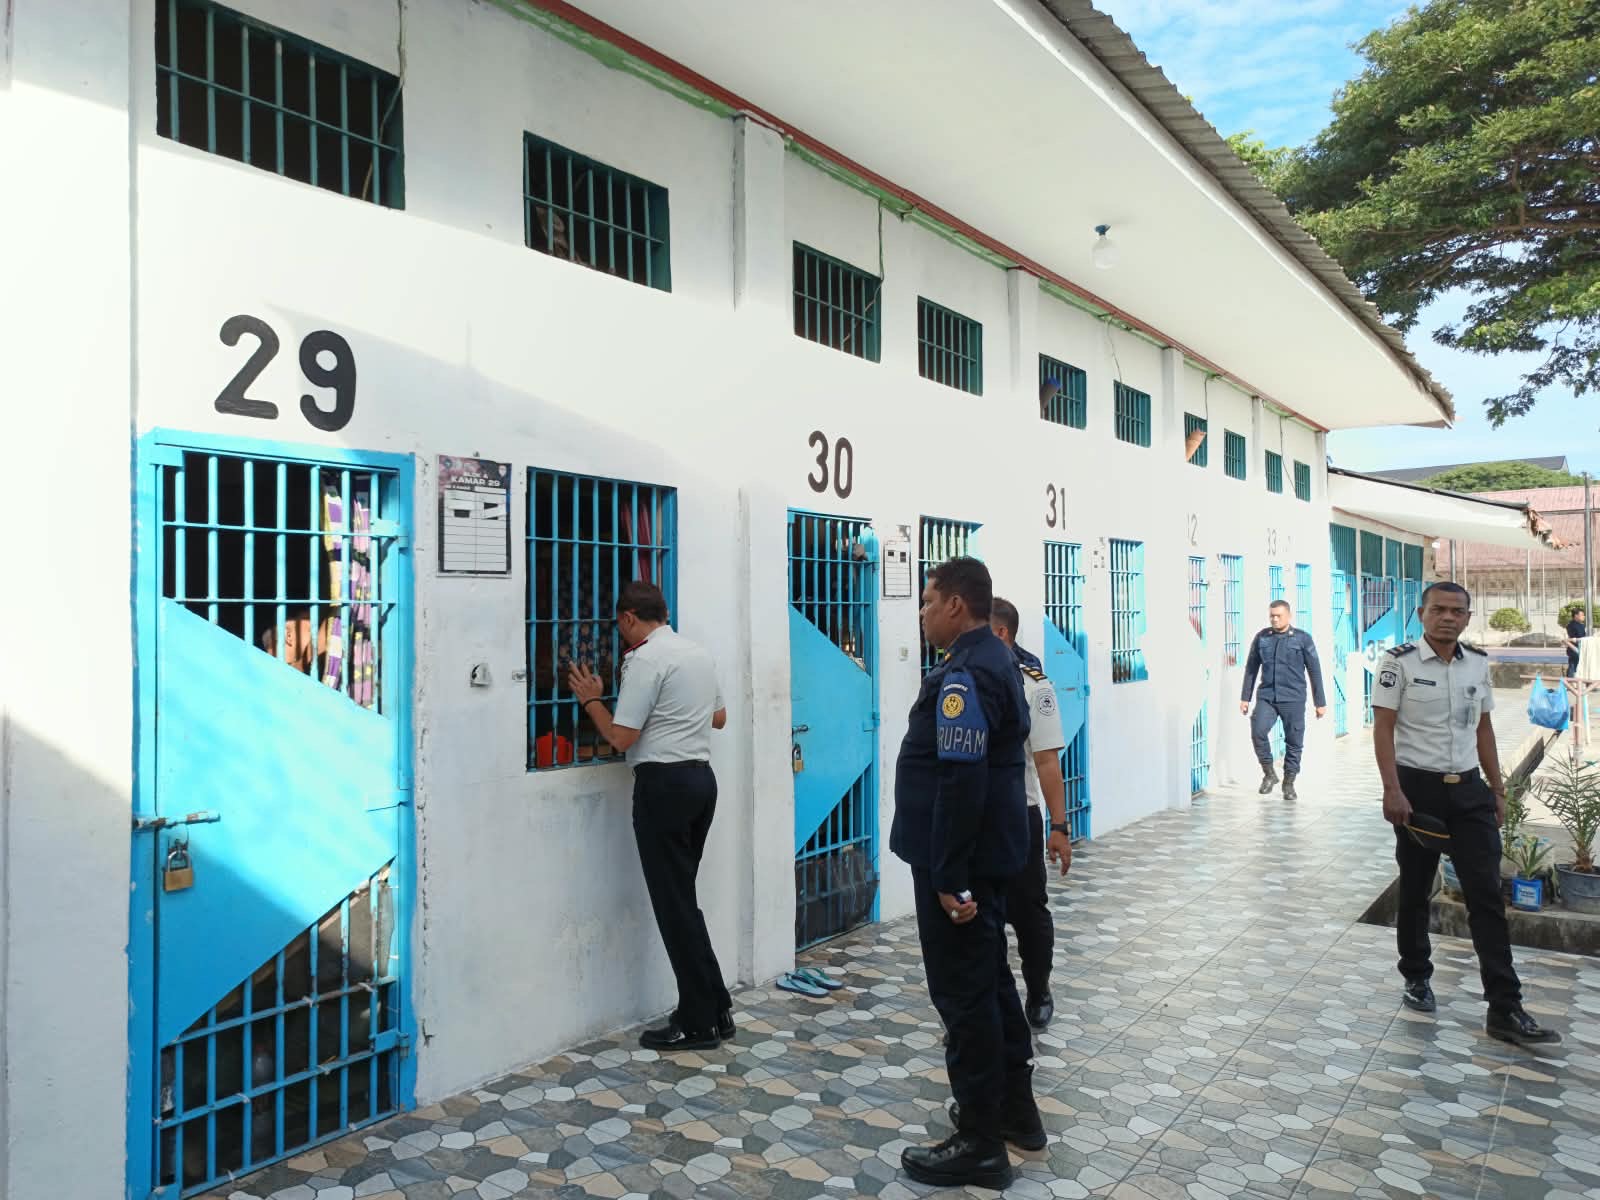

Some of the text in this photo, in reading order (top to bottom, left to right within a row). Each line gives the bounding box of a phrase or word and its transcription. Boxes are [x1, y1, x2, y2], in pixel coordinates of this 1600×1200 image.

[214, 314, 357, 432] 29
[451, 476, 486, 486] KAMAR
[807, 430, 854, 500] 30
[1046, 482, 1066, 531] 31
